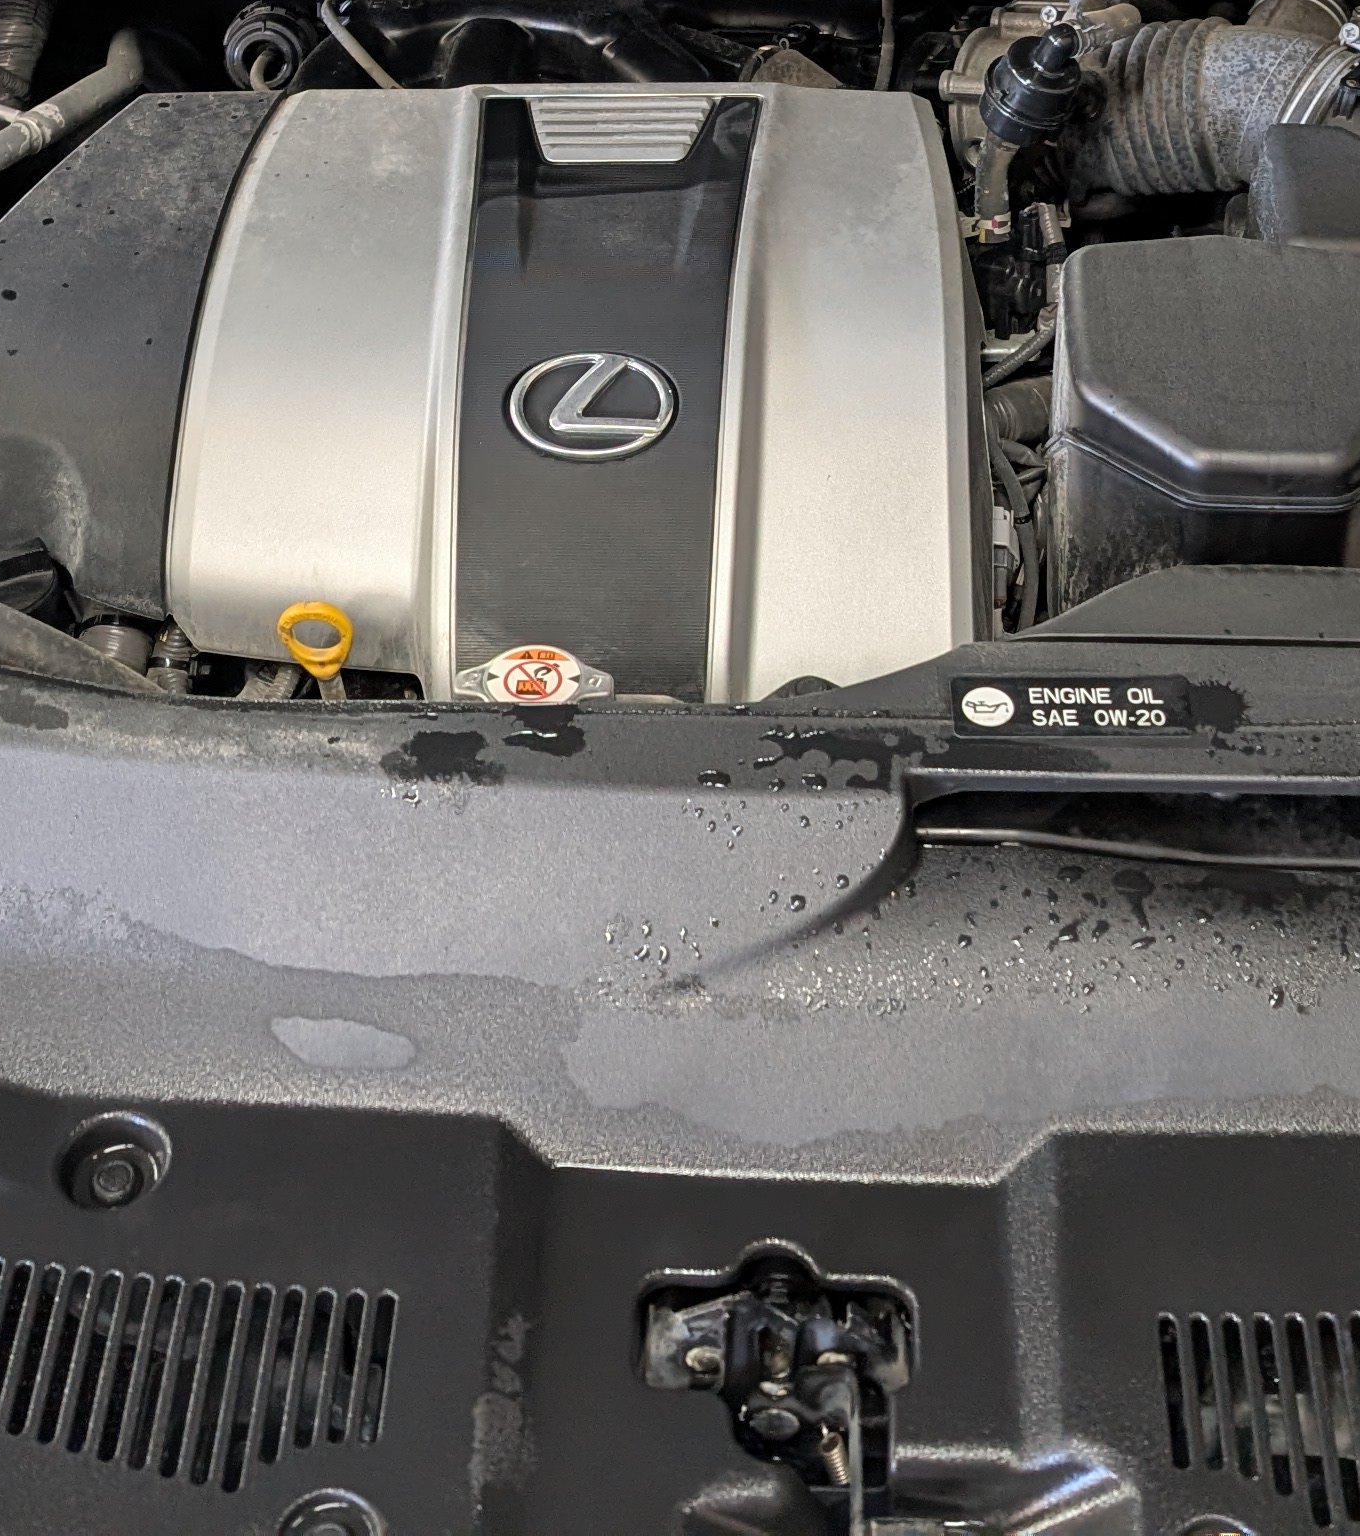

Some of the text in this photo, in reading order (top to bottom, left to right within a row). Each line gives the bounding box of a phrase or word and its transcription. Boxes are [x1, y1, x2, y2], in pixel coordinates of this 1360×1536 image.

[1027, 687, 1165, 705] ENGINE OIL
[1031, 709, 1167, 727] SAE 0W-20
